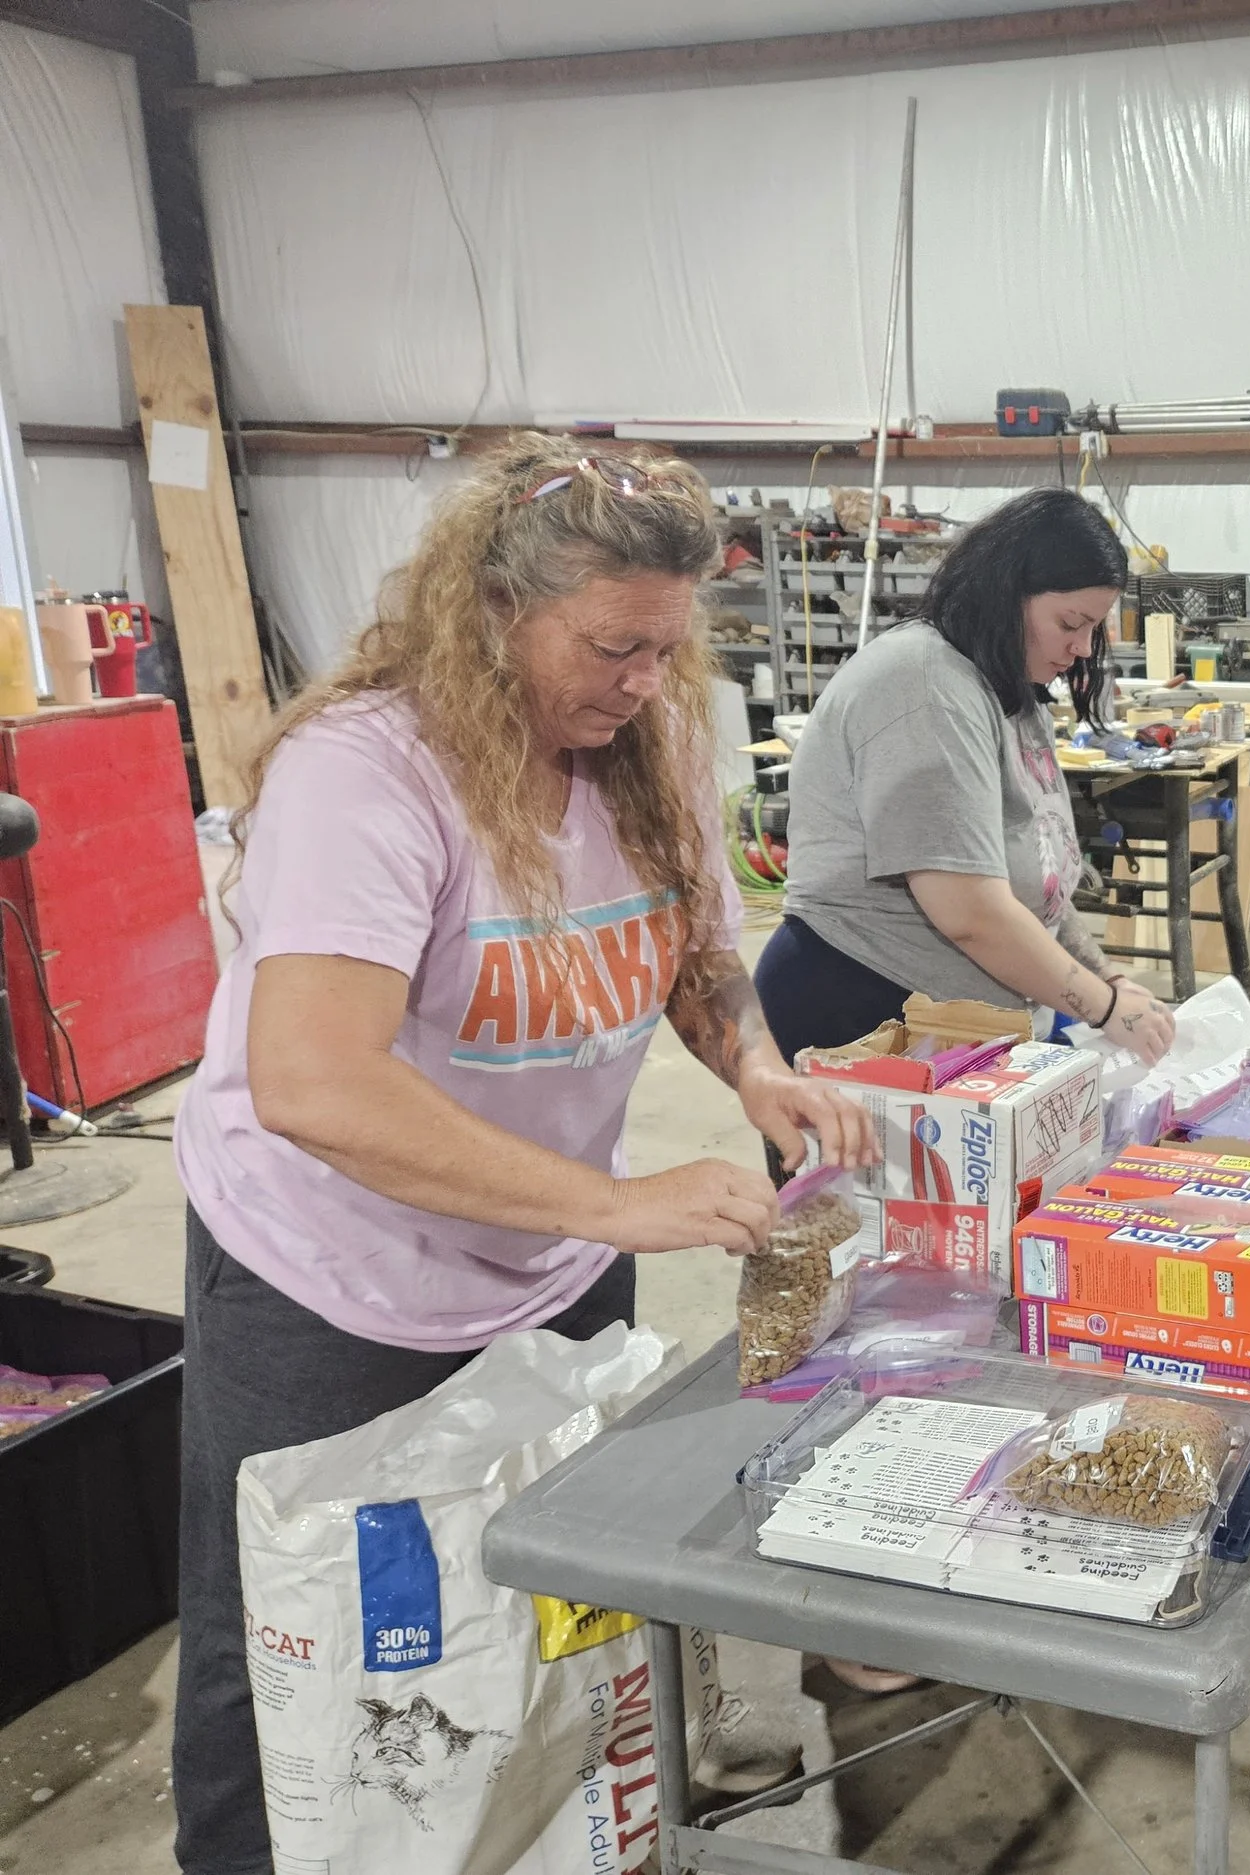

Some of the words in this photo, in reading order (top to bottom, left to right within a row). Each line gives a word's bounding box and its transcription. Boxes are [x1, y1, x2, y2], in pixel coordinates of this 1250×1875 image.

[961, 1118, 992, 1197] Ziploc
[1109, 1161, 1188, 1177] GALLON
[1190, 1171, 1242, 1184] HALF
[1042, 1203, 1125, 1219] GALLON
[1124, 1212, 1180, 1229] HALF
[945, 1229, 953, 1264] MOYEN
[954, 1214, 974, 1257] 946
[975, 1220, 986, 1273] ENTREPOSA
[1120, 1227, 1208, 1249] Hefty
[1027, 1303, 1038, 1356] STORAGE
[1131, 1353, 1200, 1384] Hefty
[861, 1532, 918, 1549] Feeding
[1078, 1557, 1147, 1573] Guidelines
[1080, 1565, 1140, 1581] Feeding
[375, 1624, 430, 1649] 30%
[376, 1646, 429, 1664] PROTEIN
[589, 1682, 609, 1720] For
[604, 1661, 662, 1875] MULT
[587, 1814, 616, 1875] Adul
